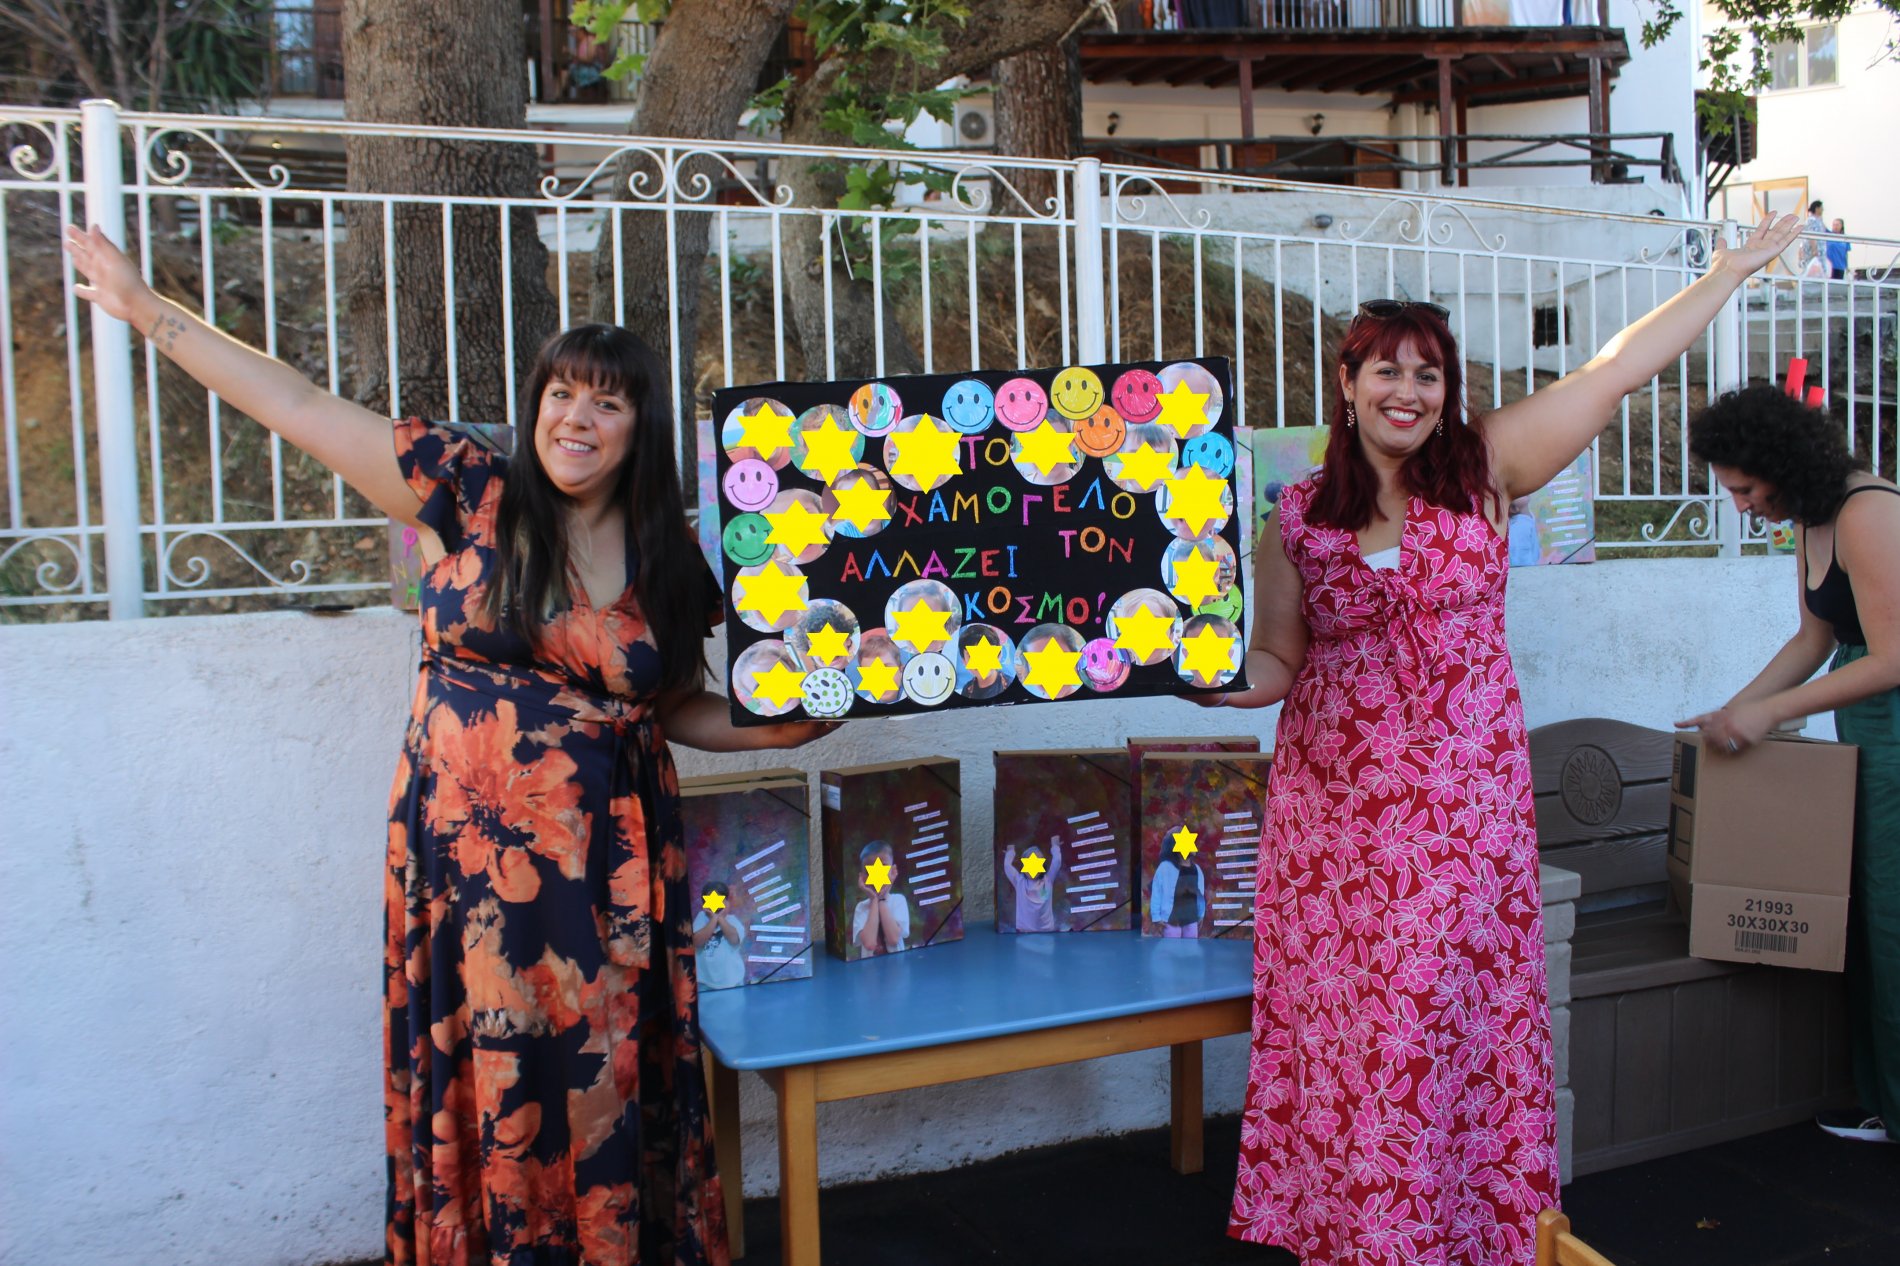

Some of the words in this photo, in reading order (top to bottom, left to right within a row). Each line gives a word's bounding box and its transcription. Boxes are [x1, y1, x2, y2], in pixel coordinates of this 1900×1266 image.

[960, 435, 1010, 470] ΤΟ
[898, 477, 1136, 527] ΧΑΜΟΓΕΛΟ
[840, 545, 1018, 582] ΑΛΛΑΖΕΙ
[1058, 526, 1134, 563] ΤΟΝ
[964, 586, 1106, 625] ΚΟΣΜΟ!
[1727, 914, 1809, 934] 30X30X30
[1745, 899, 1793, 916] 21993
